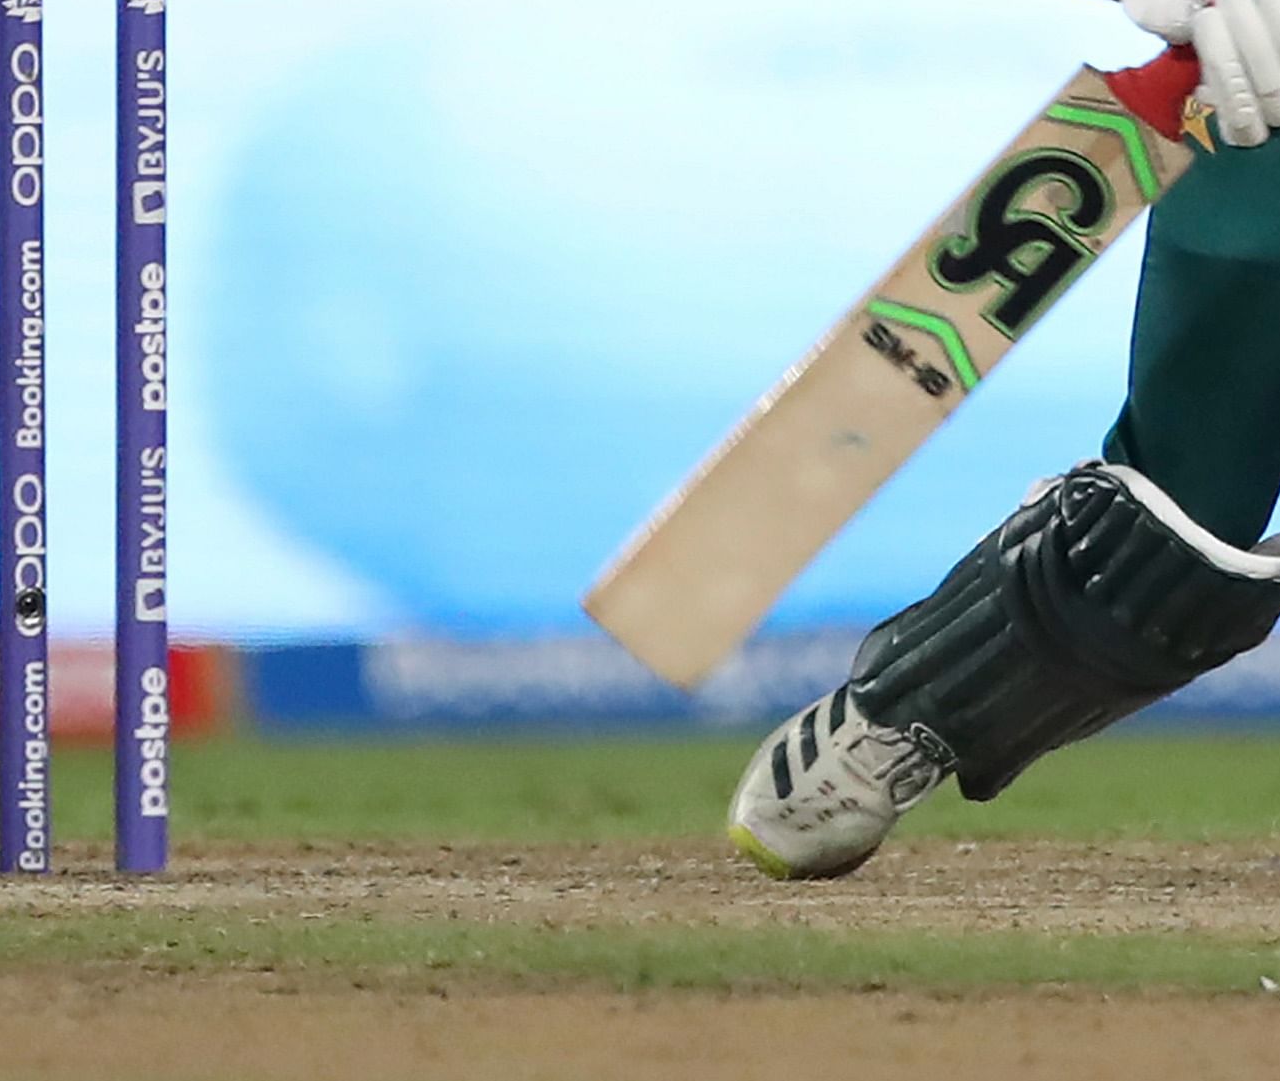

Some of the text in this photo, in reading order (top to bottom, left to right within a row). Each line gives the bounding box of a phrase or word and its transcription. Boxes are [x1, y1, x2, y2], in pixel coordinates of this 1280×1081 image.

[11, 43, 43, 206] oppo
[136, 49, 165, 176] BYJU'S
[15, 240, 43, 448] Booking.com
[135, 262, 167, 411] postpe
[140, 446, 166, 574] BYJU'S
[18, 661, 48, 870] Booking.com
[134, 667, 169, 817] postpe
